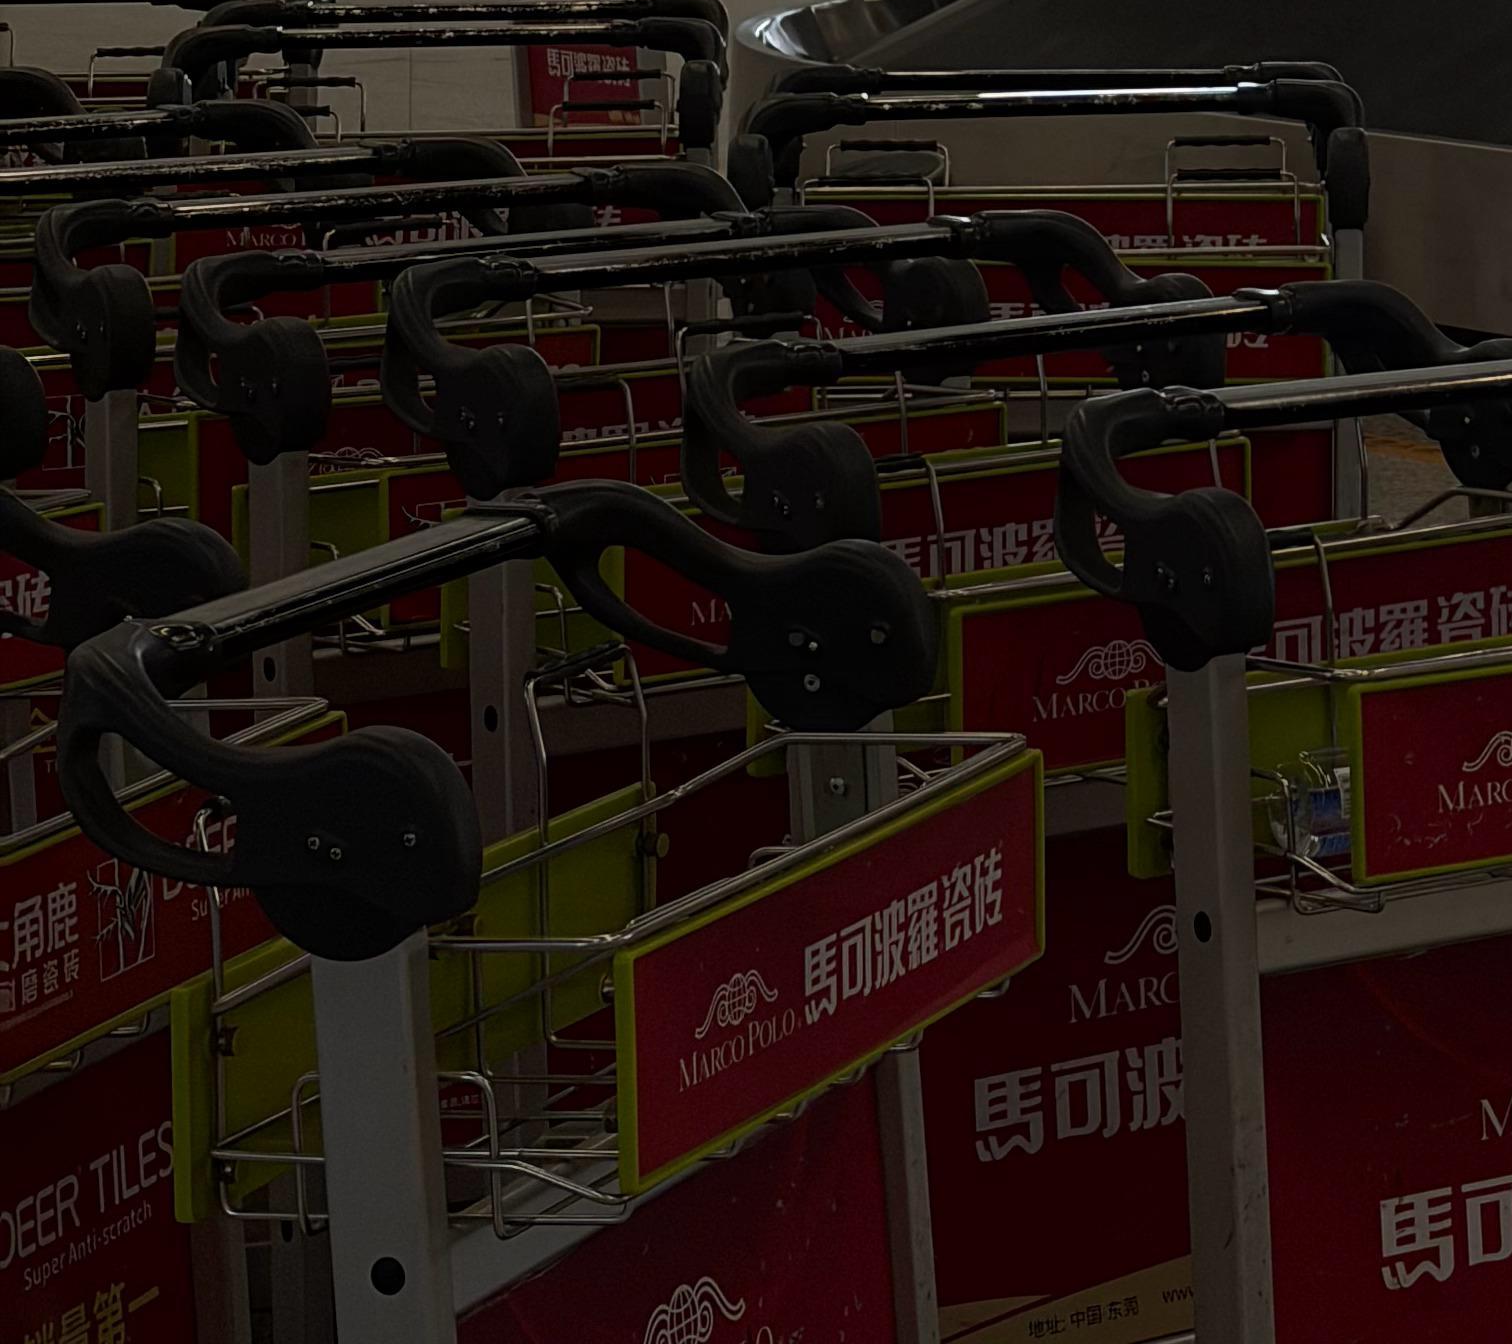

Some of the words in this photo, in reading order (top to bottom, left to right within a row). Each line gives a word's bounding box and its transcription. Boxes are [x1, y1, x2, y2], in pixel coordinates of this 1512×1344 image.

[1032, 686, 1127, 723] MARCO
[1068, 968, 1180, 1024] MARC
[679, 1036, 743, 1095] MARCO
[747, 1005, 800, 1063] POLO
[973, 1036, 1186, 1164] 馬可波
[89, 1119, 174, 1215] TILES
[23, 1252, 66, 1293] Super
[69, 1198, 152, 1266] Anti-scratch
